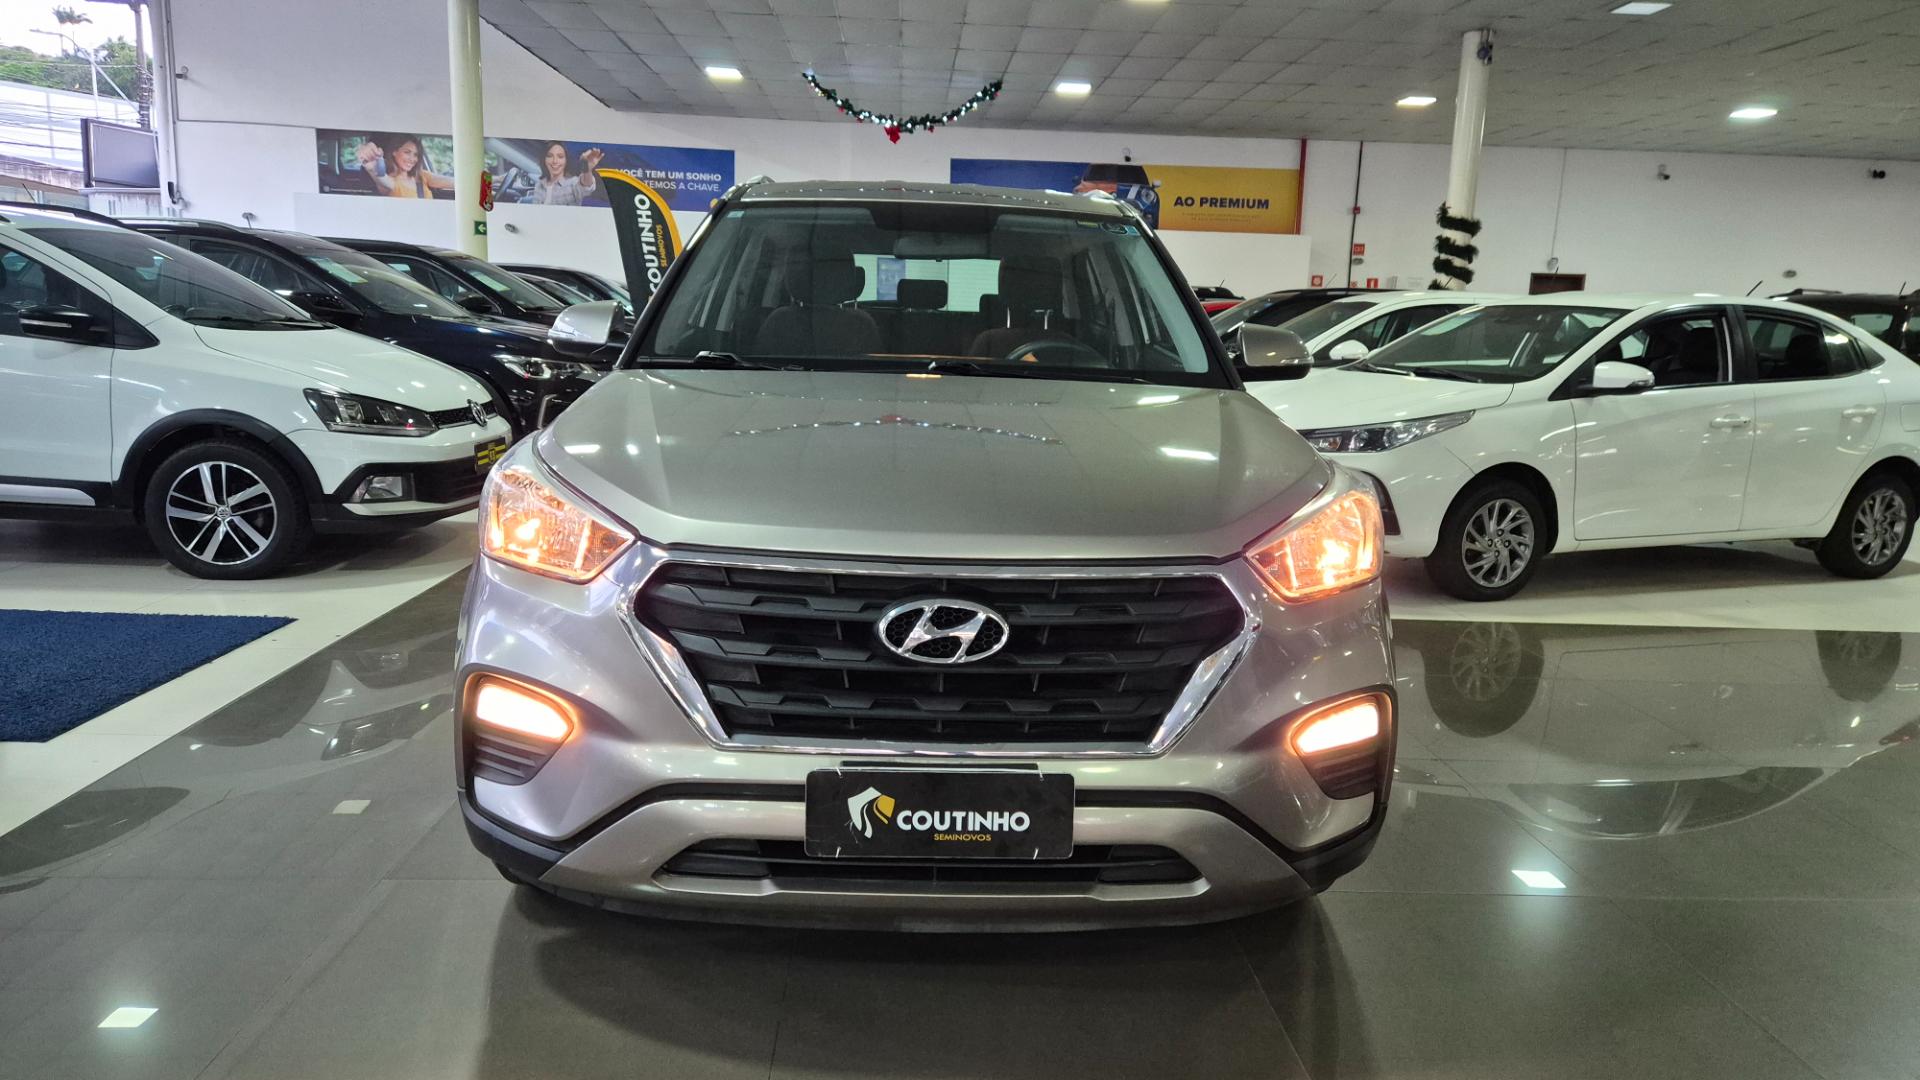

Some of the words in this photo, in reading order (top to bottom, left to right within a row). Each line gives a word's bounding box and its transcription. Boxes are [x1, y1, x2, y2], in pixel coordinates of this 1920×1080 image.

[645, 170, 666, 179] TEM
[667, 171, 684, 180] UM
[686, 172, 722, 182] SONHO
[678, 182, 686, 190] A
[1173, 196, 1195, 207] AO
[1199, 197, 1270, 210] PREMIUM
[656, 224, 668, 268] SEMINOVOS
[896, 809, 1031, 832] COUTINHO
[934, 833, 992, 842] SEMINOVOS
